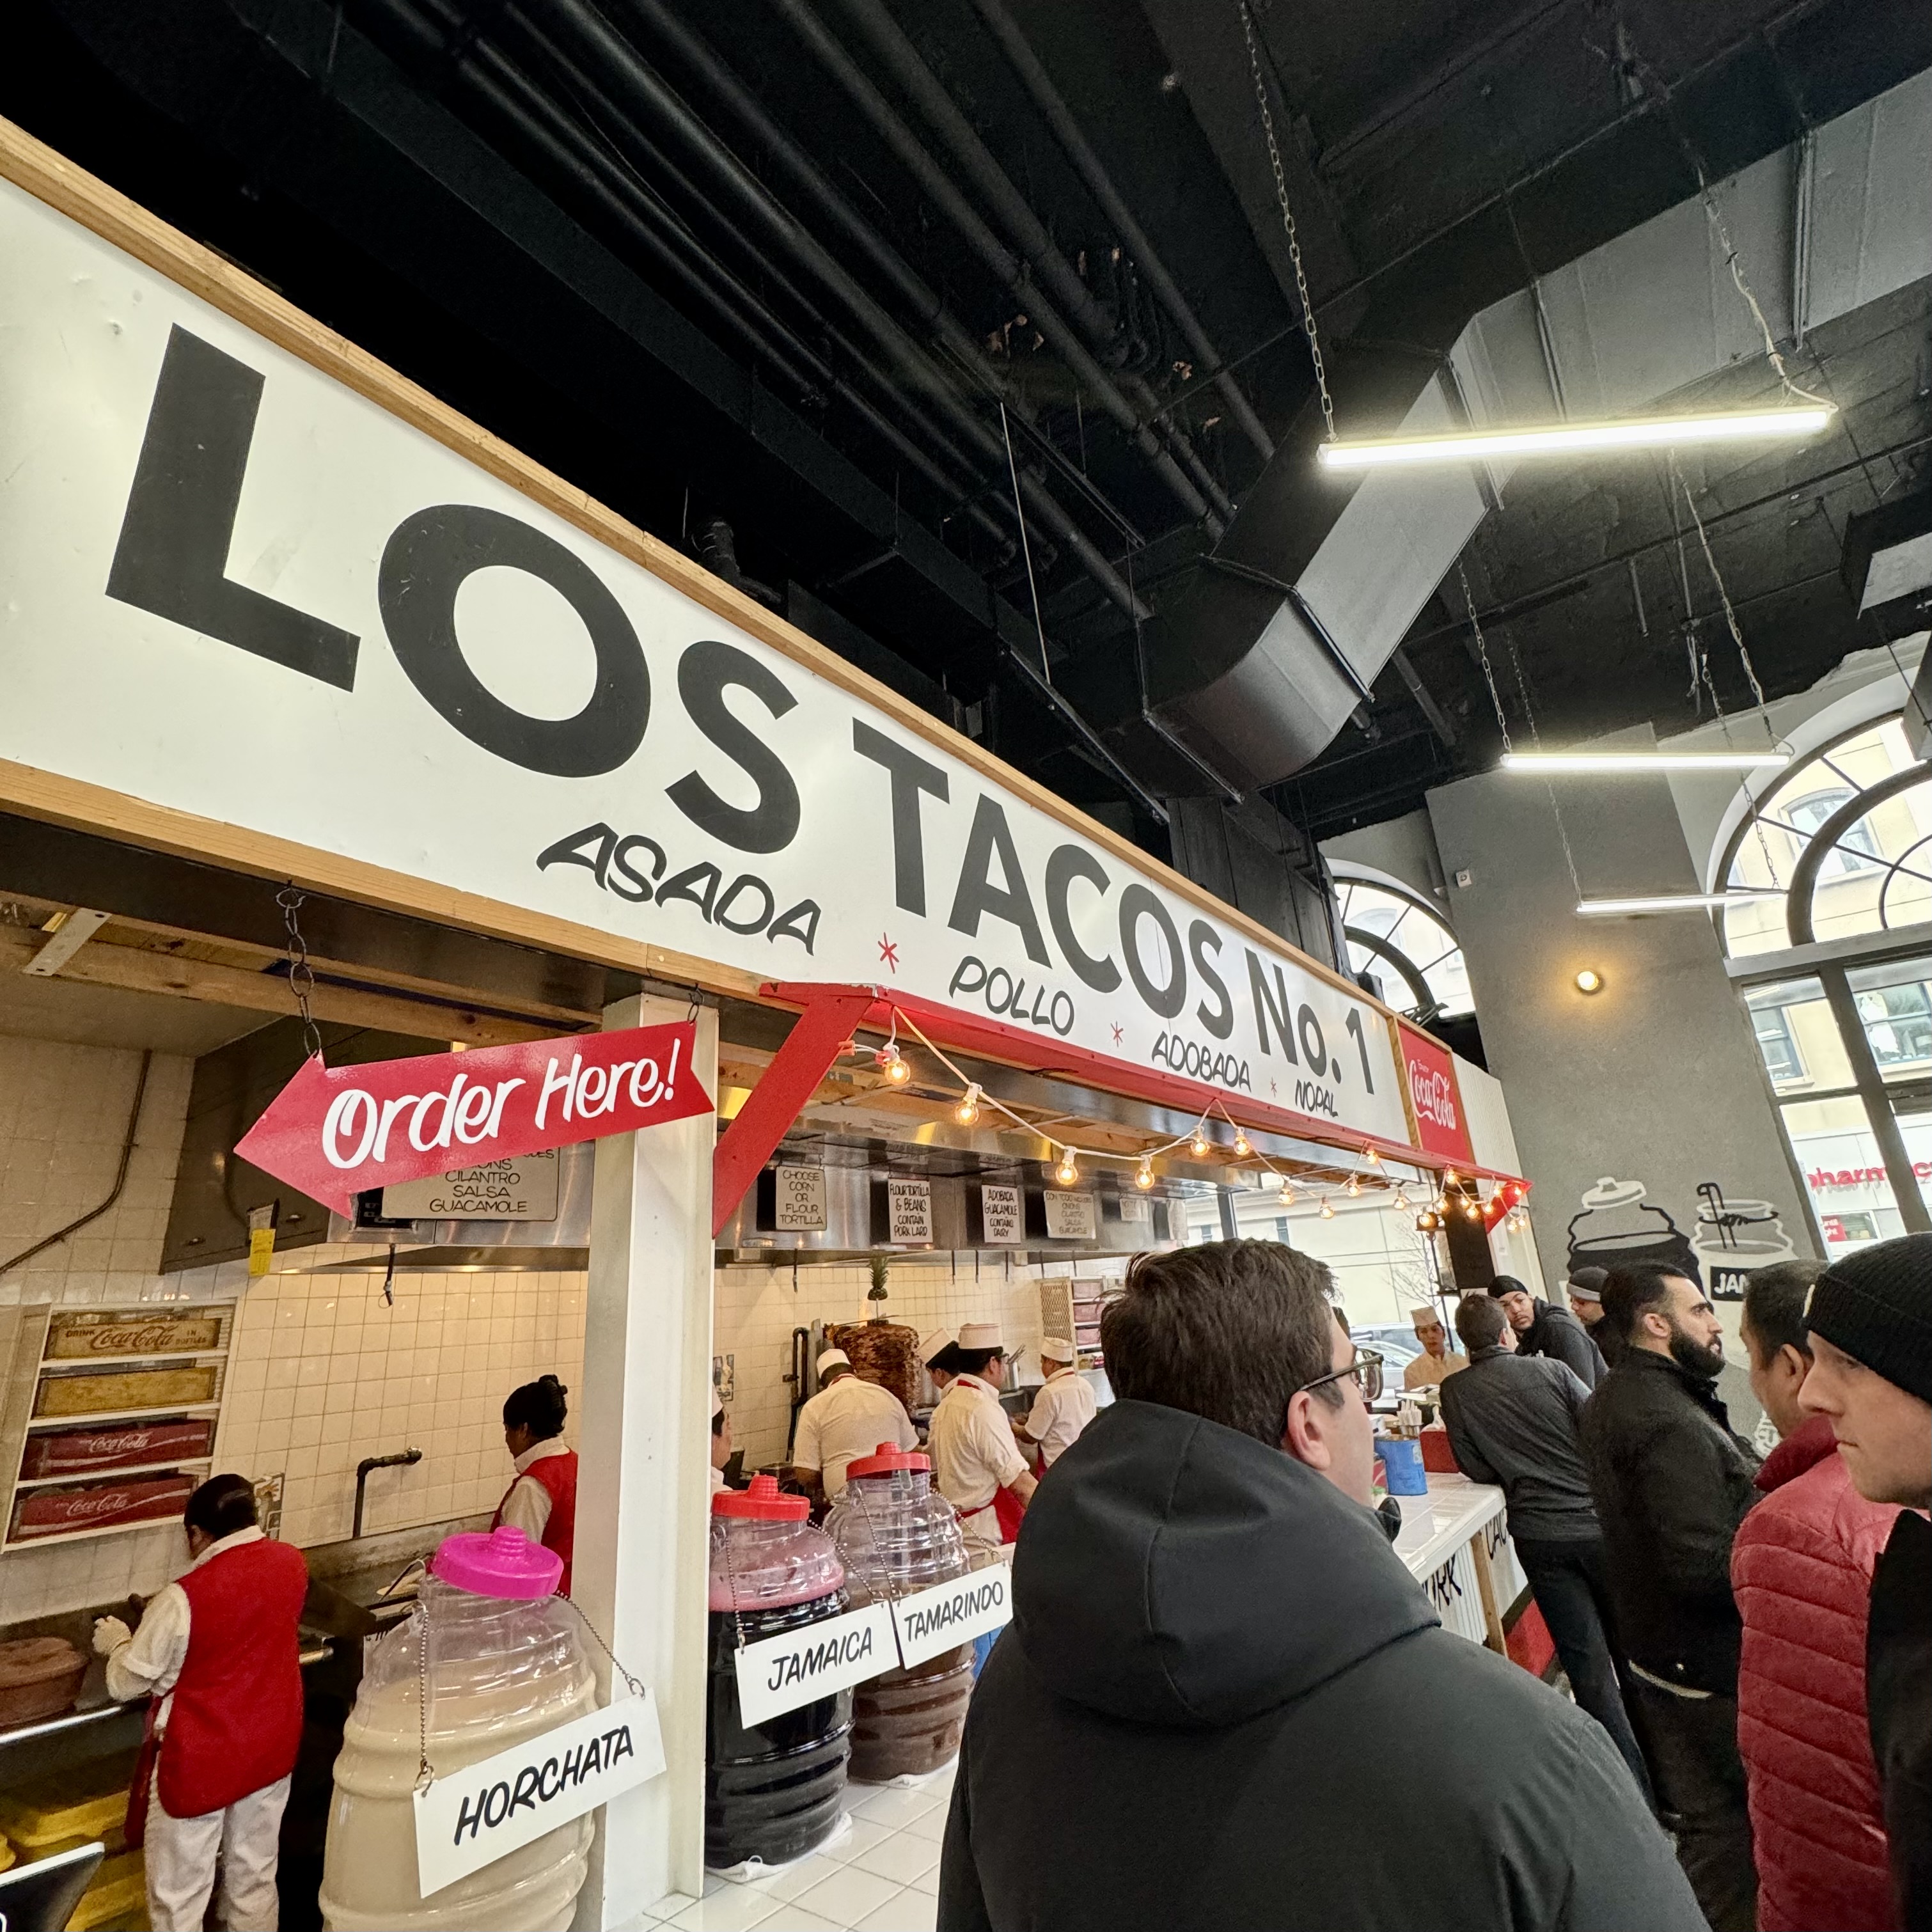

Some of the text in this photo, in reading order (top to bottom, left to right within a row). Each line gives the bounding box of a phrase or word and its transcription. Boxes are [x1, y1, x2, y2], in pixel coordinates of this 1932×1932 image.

[105, 322, 1374, 1095] LOS TACOS No. 1
[536, 822, 822, 957] ASADA
[948, 955, 1074, 1036] POLLO
[1151, 1030, 1252, 1092] ADOBADA
[322, 1038, 681, 1169] Order Here!
[1294, 1078, 1339, 1118] NOPAL
[444, 1170, 521, 1185] CILANTRO
[782, 1169, 821, 1181] CHOOSE
[452, 1184, 511, 1198] SALSA
[789, 1181, 815, 1191] CORN
[795, 1192, 808, 1202] OR
[904, 1197, 927, 1213] BEANS
[428, 1198, 528, 1213] GUACAMOLE
[785, 1203, 819, 1214] FLOUR
[780, 1214, 824, 1225] TORTILLA
[65, 1329, 95, 1339] DRINK
[904, 1579, 1005, 1642] TAMARINDO
[767, 1626, 872, 1692] JAMAICA
[453, 1724, 634, 1846] HORCHATA
